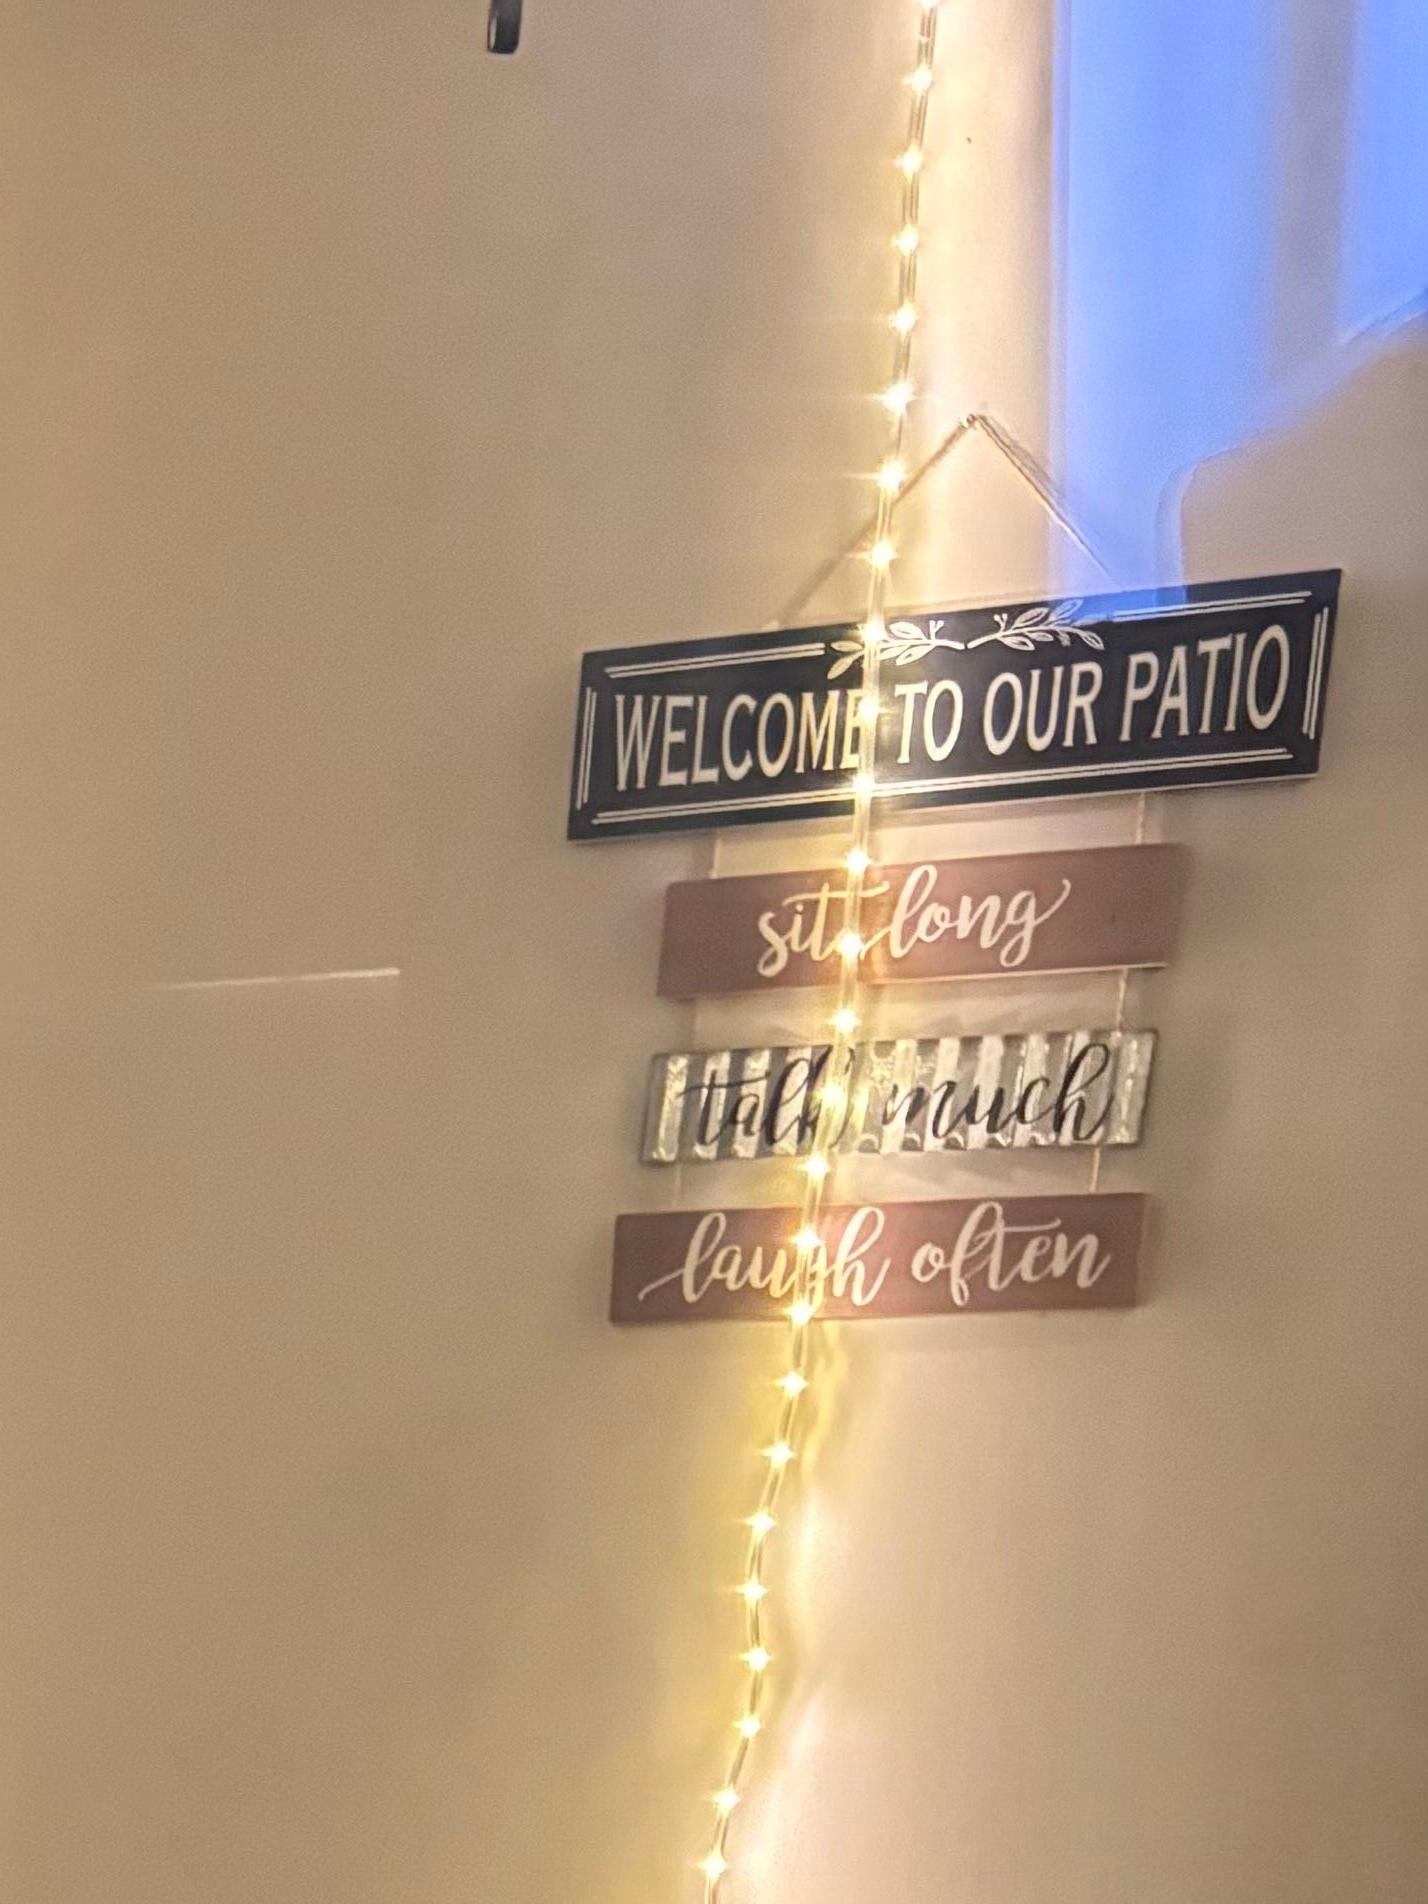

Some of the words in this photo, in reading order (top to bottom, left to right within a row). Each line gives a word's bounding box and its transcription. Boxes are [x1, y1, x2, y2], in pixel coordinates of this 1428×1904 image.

[615, 686, 877, 792] WELCOME
[894, 679, 964, 764] TO
[983, 661, 1103, 756] OUR
[1120, 624, 1290, 742] PATIO
[757, 882, 890, 978] sit
[860, 864, 1071, 968] long
[881, 1042, 1116, 1142] much
[911, 1200, 1111, 1306] often
